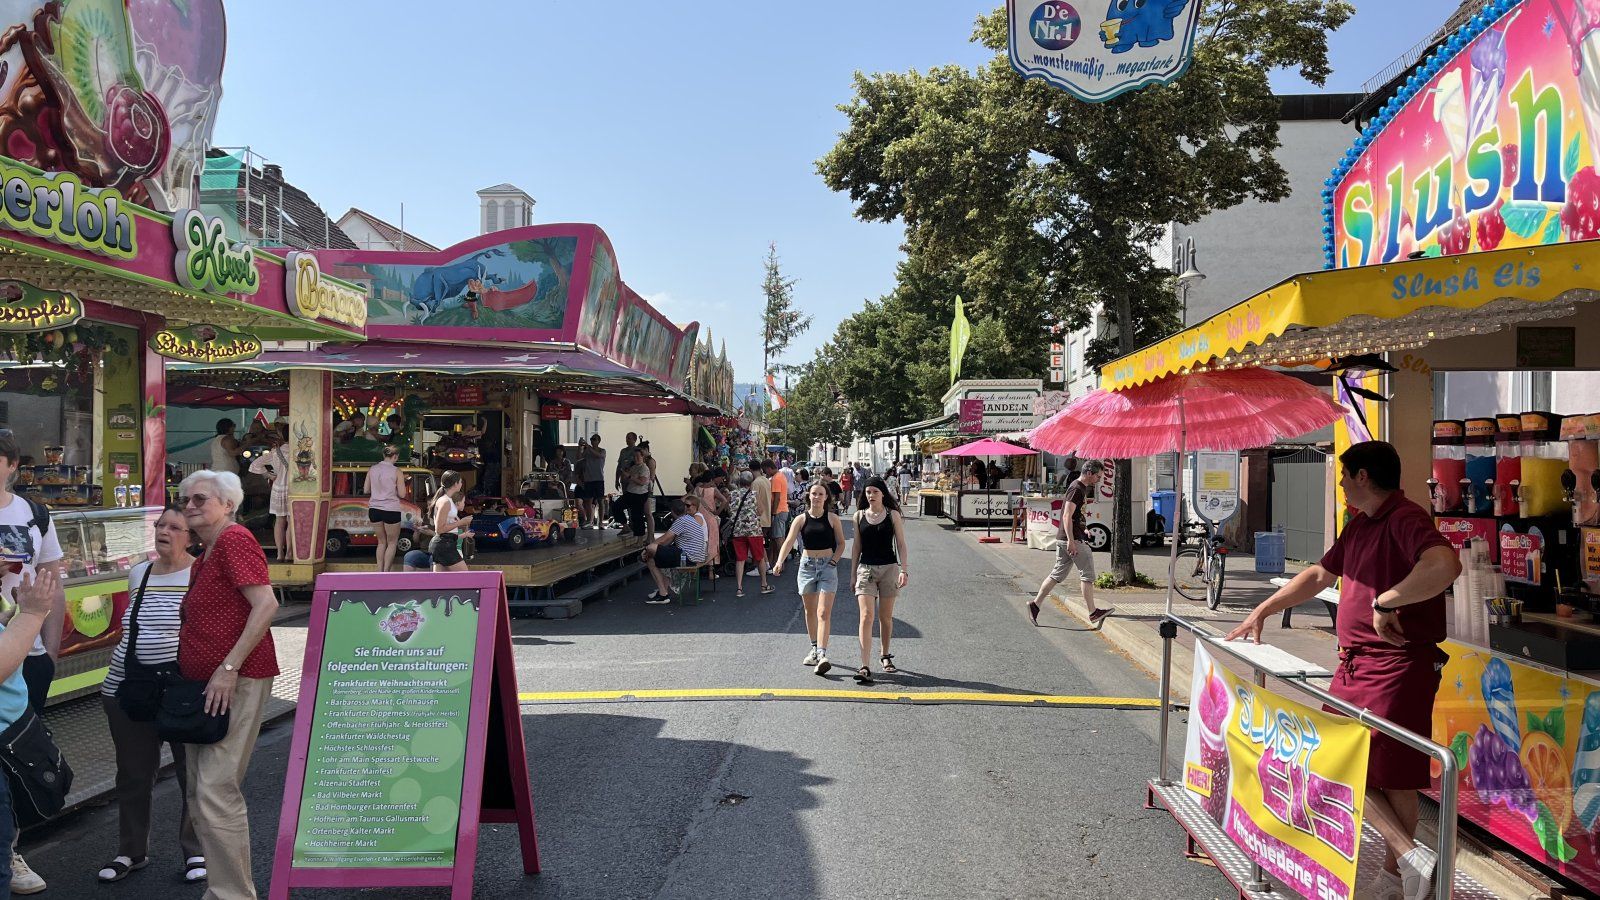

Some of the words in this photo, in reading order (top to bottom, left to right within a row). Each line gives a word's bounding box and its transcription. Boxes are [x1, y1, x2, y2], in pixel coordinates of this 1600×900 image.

[1034, 20, 1074, 41] Nr.1
[1106, 54, 1174, 77] ...megastark
[189, 215, 256, 287] Kiwi
[1391, 270, 1479, 300] Slush
[1493, 262, 1541, 288] Eis
[297, 258, 365, 321] Banane
[156, 331, 257, 360] Schokofrüchte
[354, 647, 369, 657] Sie
[372, 646, 404, 657] finden
[406, 649, 425, 657] uns
[427, 646, 446, 657] auf
[327, 661, 379, 674] folgenden
[381, 660, 469, 673] Veranstaltungen:
[333, 680, 378, 688] Frankfurter
[379, 679, 448, 688] Weihnachtsmarkt
[330, 698, 370, 707] Barbarossa
[371, 698, 395, 706] Markt,
[396, 697, 439, 706] Gelnhausen
[328, 710, 370, 718] Frankfurter
[327, 721, 369, 729] Offenbacher
[403, 720, 410, 728] &
[411, 720, 449, 729] Herbstfest
[325, 733, 365, 742] Frankfurter
[366, 732, 411, 743] Wäldchestag
[1236, 684, 1321, 783] SLUSH
[324, 744, 355, 752] Höchster
[356, 744, 395, 752] Schlossfest
[371, 756, 401, 765] Spessart
[402, 755, 439, 763] Festwoche
[320, 767, 361, 776] Frankfurter
[361, 767, 393, 776] Mainfest
[318, 780, 348, 788] Alzenau
[348, 779, 381, 788] Stadtfest
[317, 791, 332, 799] Bad
[332, 791, 360, 800] Vilbeler
[360, 790, 383, 799] Markt
[315, 803, 329, 811] Bad
[330, 803, 371, 813] Homburger
[372, 802, 417, 811] Laternenfest
[1258, 746, 1355, 863] EIS
[313, 815, 345, 823] Hofheim
[359, 815, 384, 823] Taunus
[385, 814, 430, 823] Gallusmarkt
[312, 827, 349, 837] Ortenberg
[350, 827, 372, 835] Kalter
[373, 826, 395, 835] Markt
[355, 839, 377, 848] Markt
[1233, 809, 1312, 890] Verschiedene
